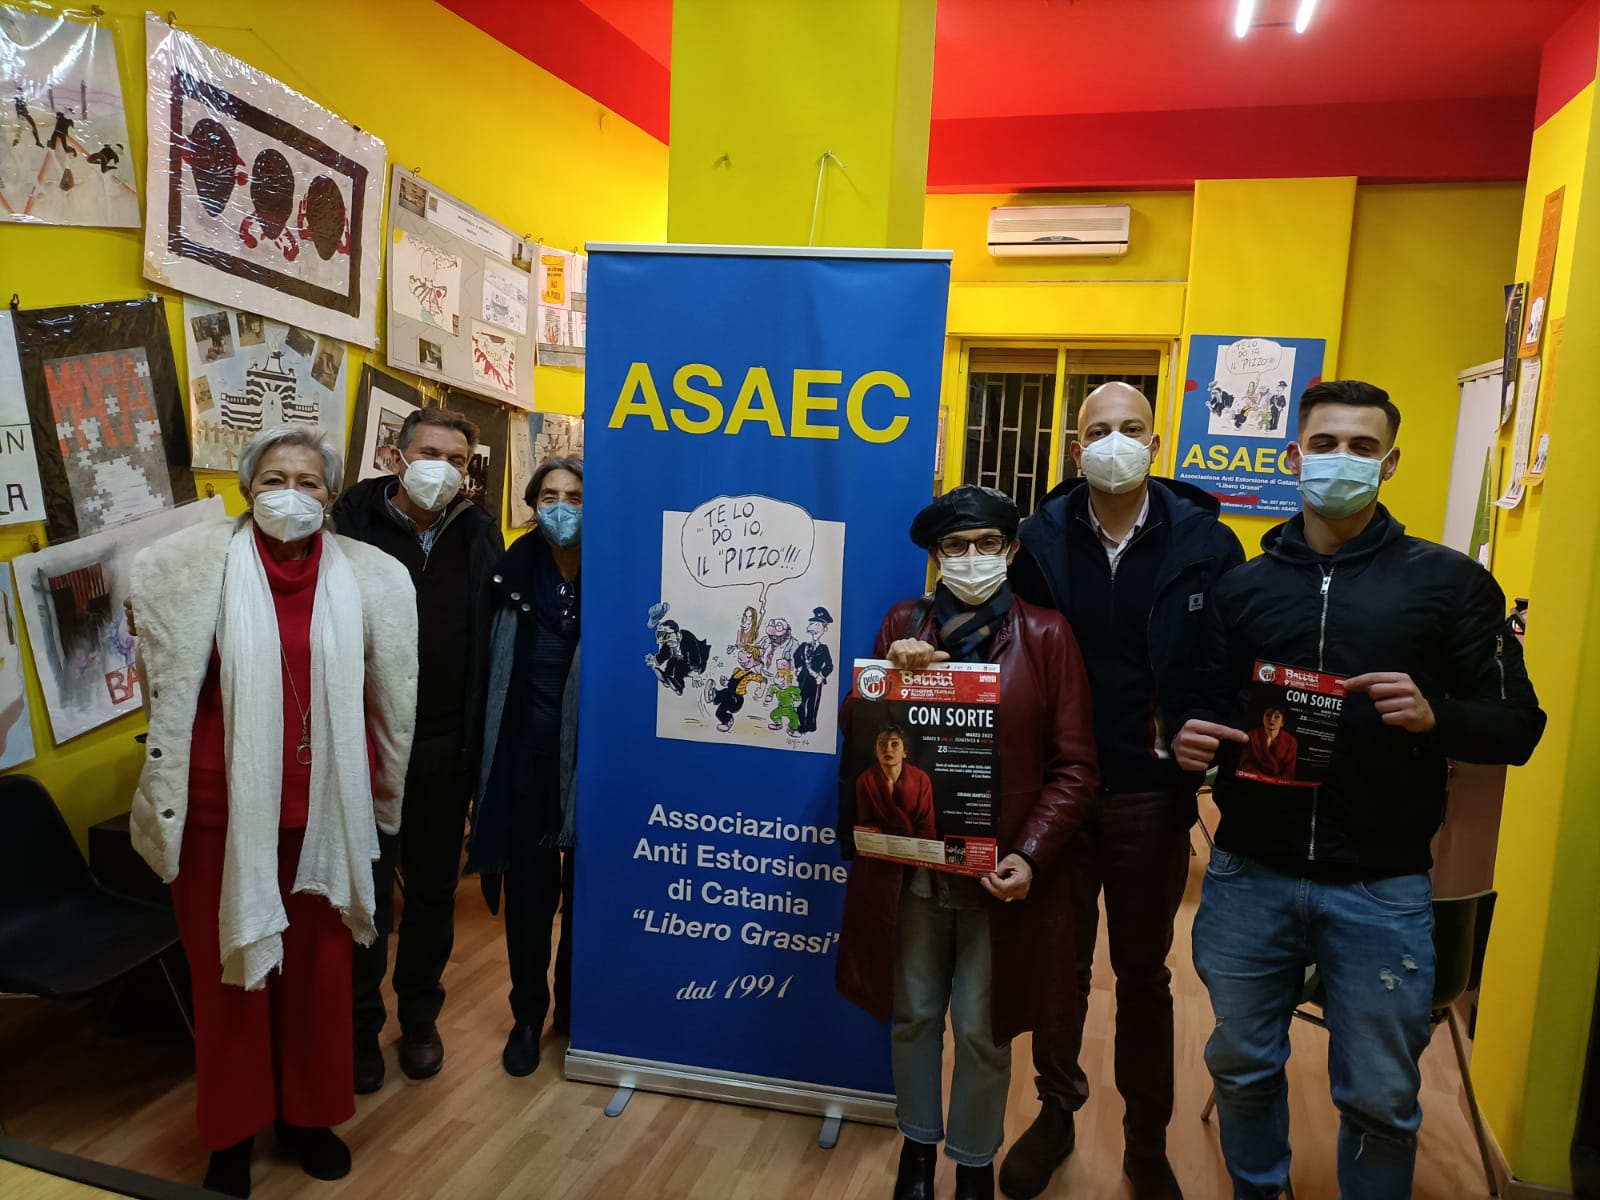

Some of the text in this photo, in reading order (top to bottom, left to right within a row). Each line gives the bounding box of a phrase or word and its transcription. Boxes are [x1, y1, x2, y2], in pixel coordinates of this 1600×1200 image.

[43, 351, 162, 459] MAFIA
[608, 362, 911, 444] ASAEC
[1181, 444, 1295, 475] ASAEC
[1180, 473, 1220, 481] Associazione
[704, 502, 755, 528] TE LO
[697, 556, 710, 577] IL
[1286, 690, 1342, 711] CON SORTE
[908, 706, 994, 728] CON SORTE
[647, 803, 837, 846] Associazione
[632, 838, 688, 866] Anti
[696, 844, 849, 884] Estorsione
[667, 878, 810, 917] di Catania
[675, 973, 794, 1001] dal 1991
